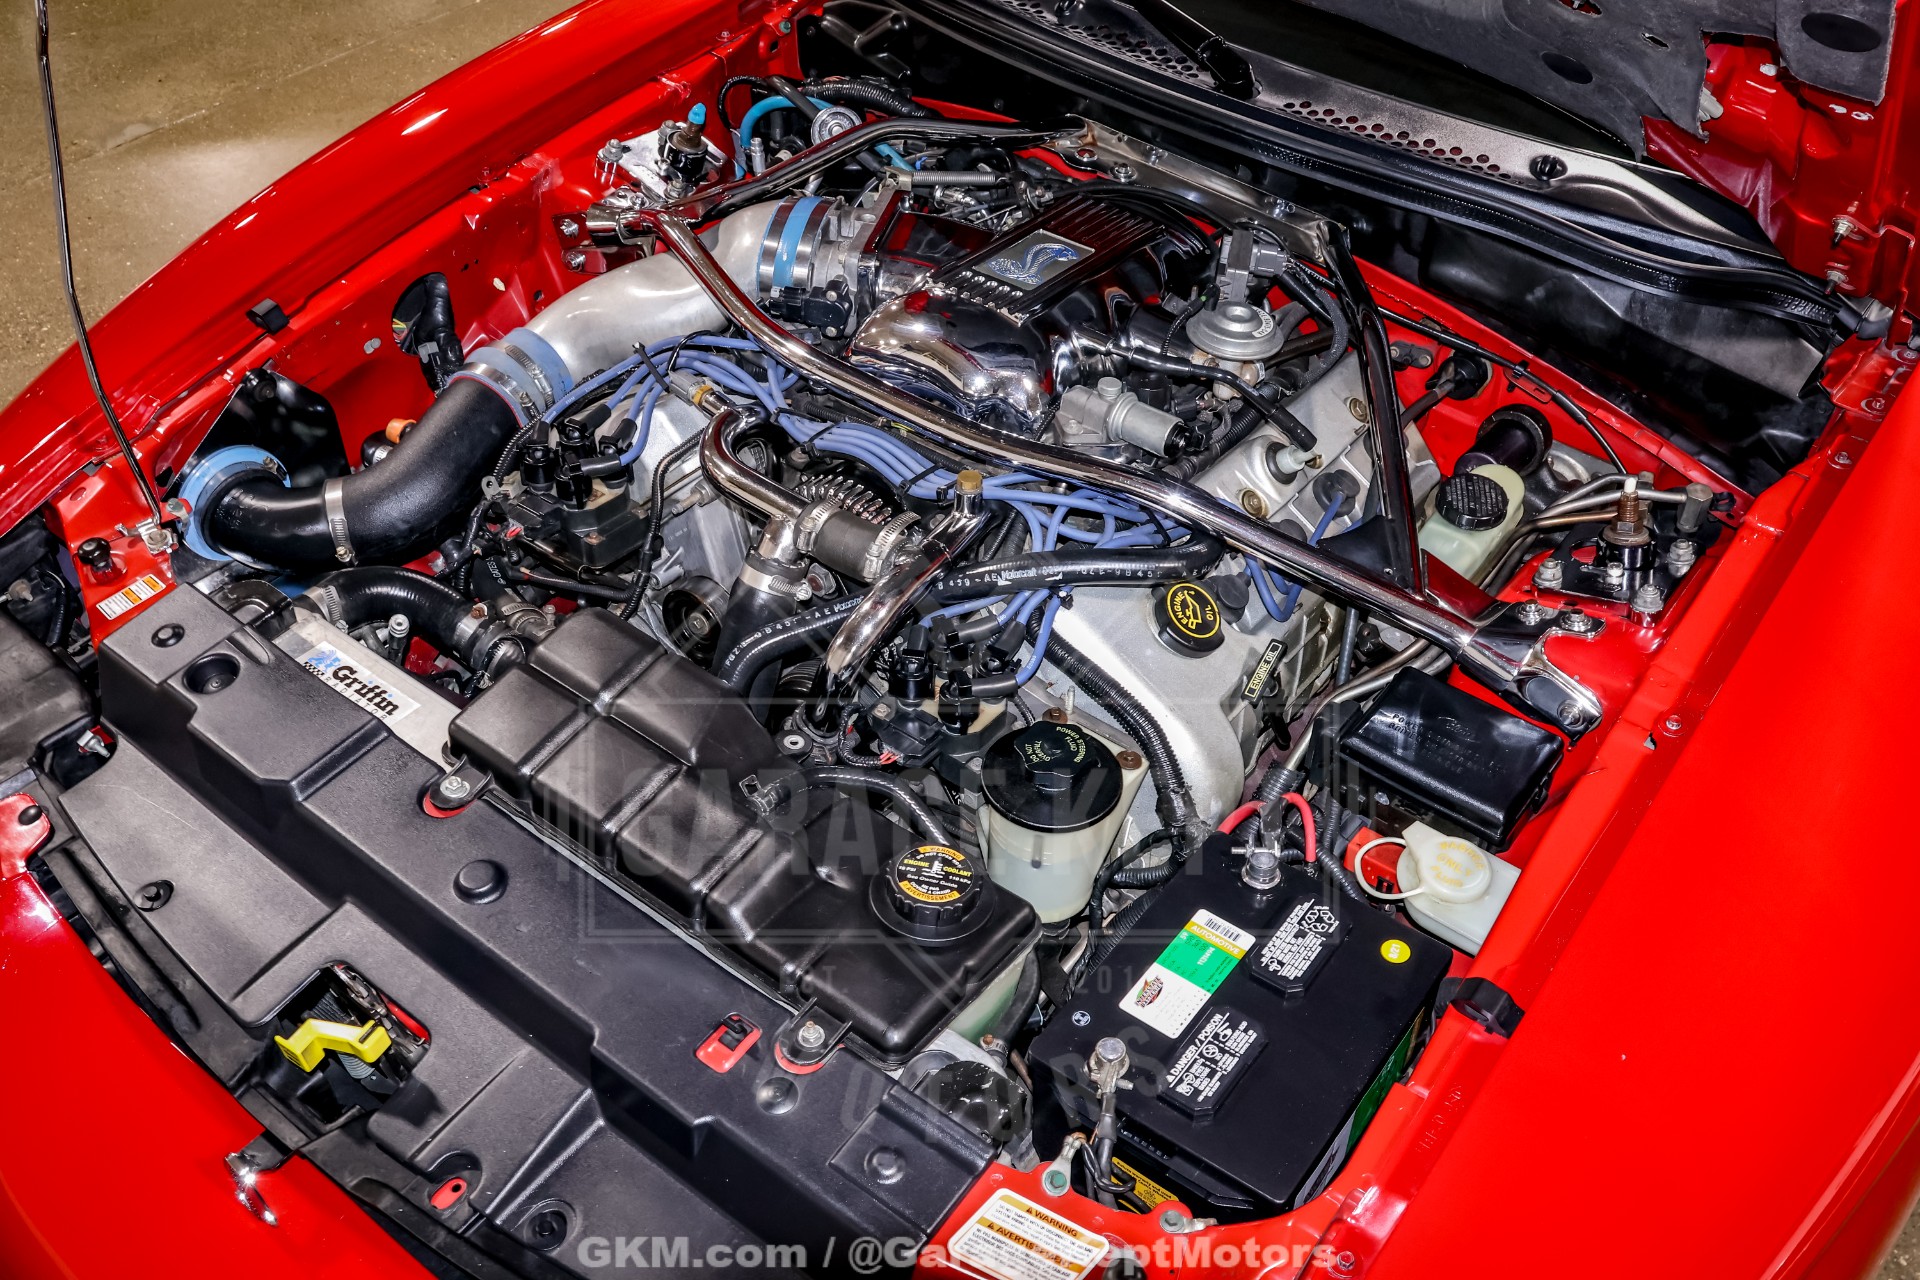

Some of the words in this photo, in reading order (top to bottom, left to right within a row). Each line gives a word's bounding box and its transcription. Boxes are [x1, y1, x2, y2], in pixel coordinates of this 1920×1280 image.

[1173, 591, 1188, 625] ENGINE
[1204, 604, 1214, 621] OIL
[1250, 661, 1270, 690] ENGINE
[1268, 650, 1278, 663] OIL
[324, 676, 388, 720] RADIATOR
[332, 665, 400, 716] Griffin
[1024, 743, 1034, 755] NOT
[1033, 740, 1051, 762] OVERFILL
[1055, 726, 1080, 740] POWER
[1073, 738, 1086, 763] STEERING
[1064, 736, 1078, 752] FLUID
[1029, 755, 1040, 763] DO
[930, 847, 962, 860] WARNING
[938, 852, 952, 861] OPEN
[903, 859, 930, 868] ENGINE
[943, 866, 972, 877] COOLANT
[919, 876, 939, 884] Owner
[940, 880, 958, 888] Guide
[906, 886, 957, 901] AVERTISSEMENT
[1191, 925, 1240, 955] AUTOMOTIVE
[1170, 1045, 1198, 1076] DANGER
[1197, 1013, 1223, 1041] POISON
[1035, 1210, 1078, 1237] WARNING
[996, 1226, 1073, 1268] AVERTISSEMENT
